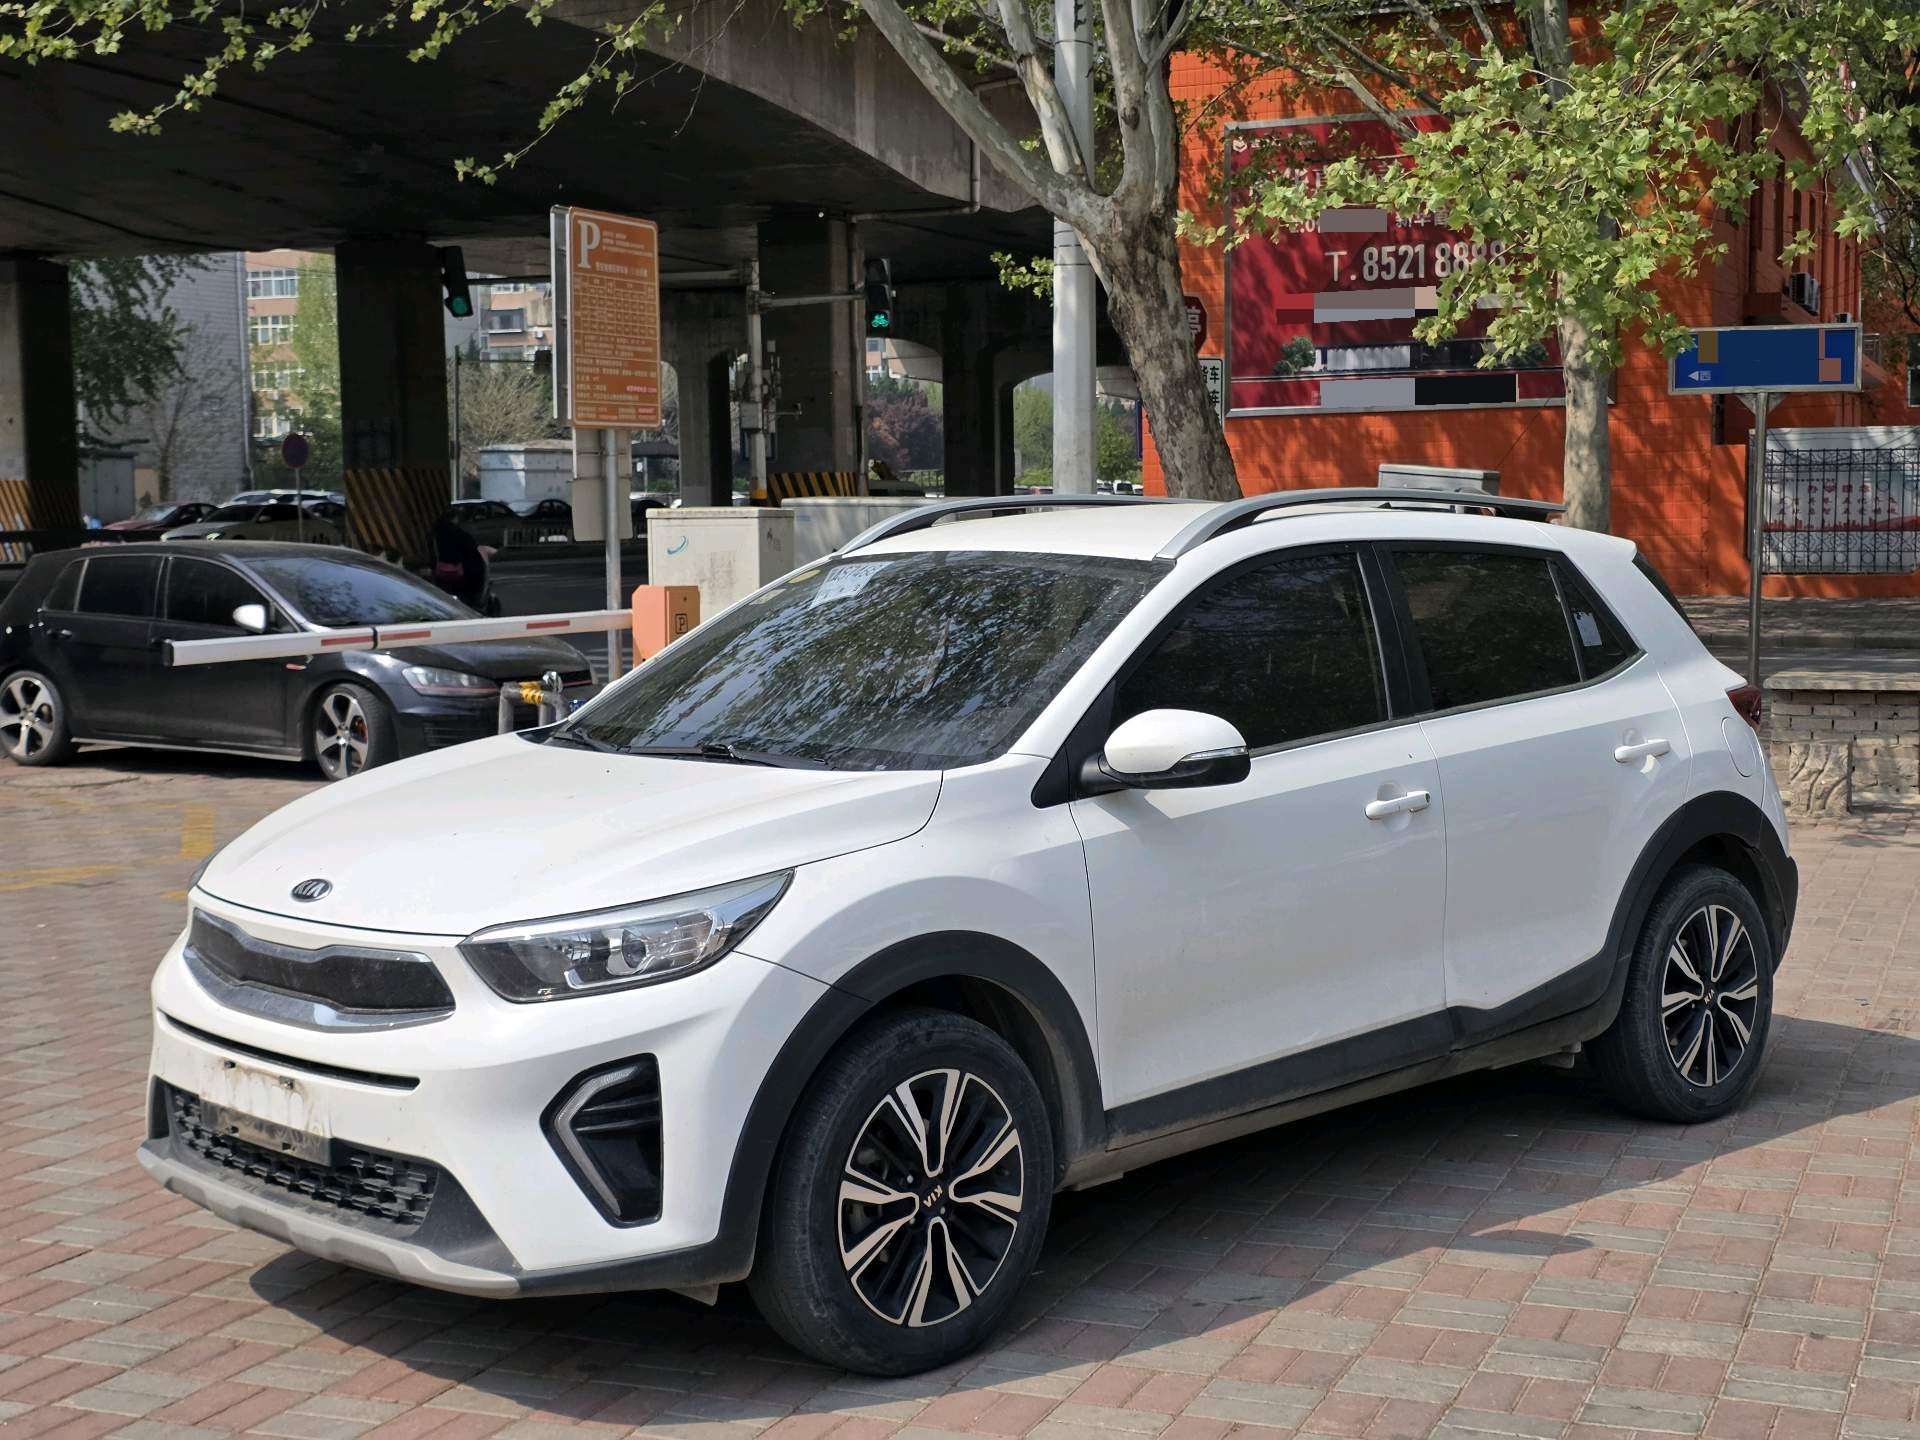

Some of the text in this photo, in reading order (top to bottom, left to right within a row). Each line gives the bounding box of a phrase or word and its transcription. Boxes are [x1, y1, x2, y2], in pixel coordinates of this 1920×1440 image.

[578, 219, 601, 269] P
[1362, 244, 1426, 281] 8521
[294, 880, 325, 897] KIA
[922, 1184, 943, 1208] KIA
